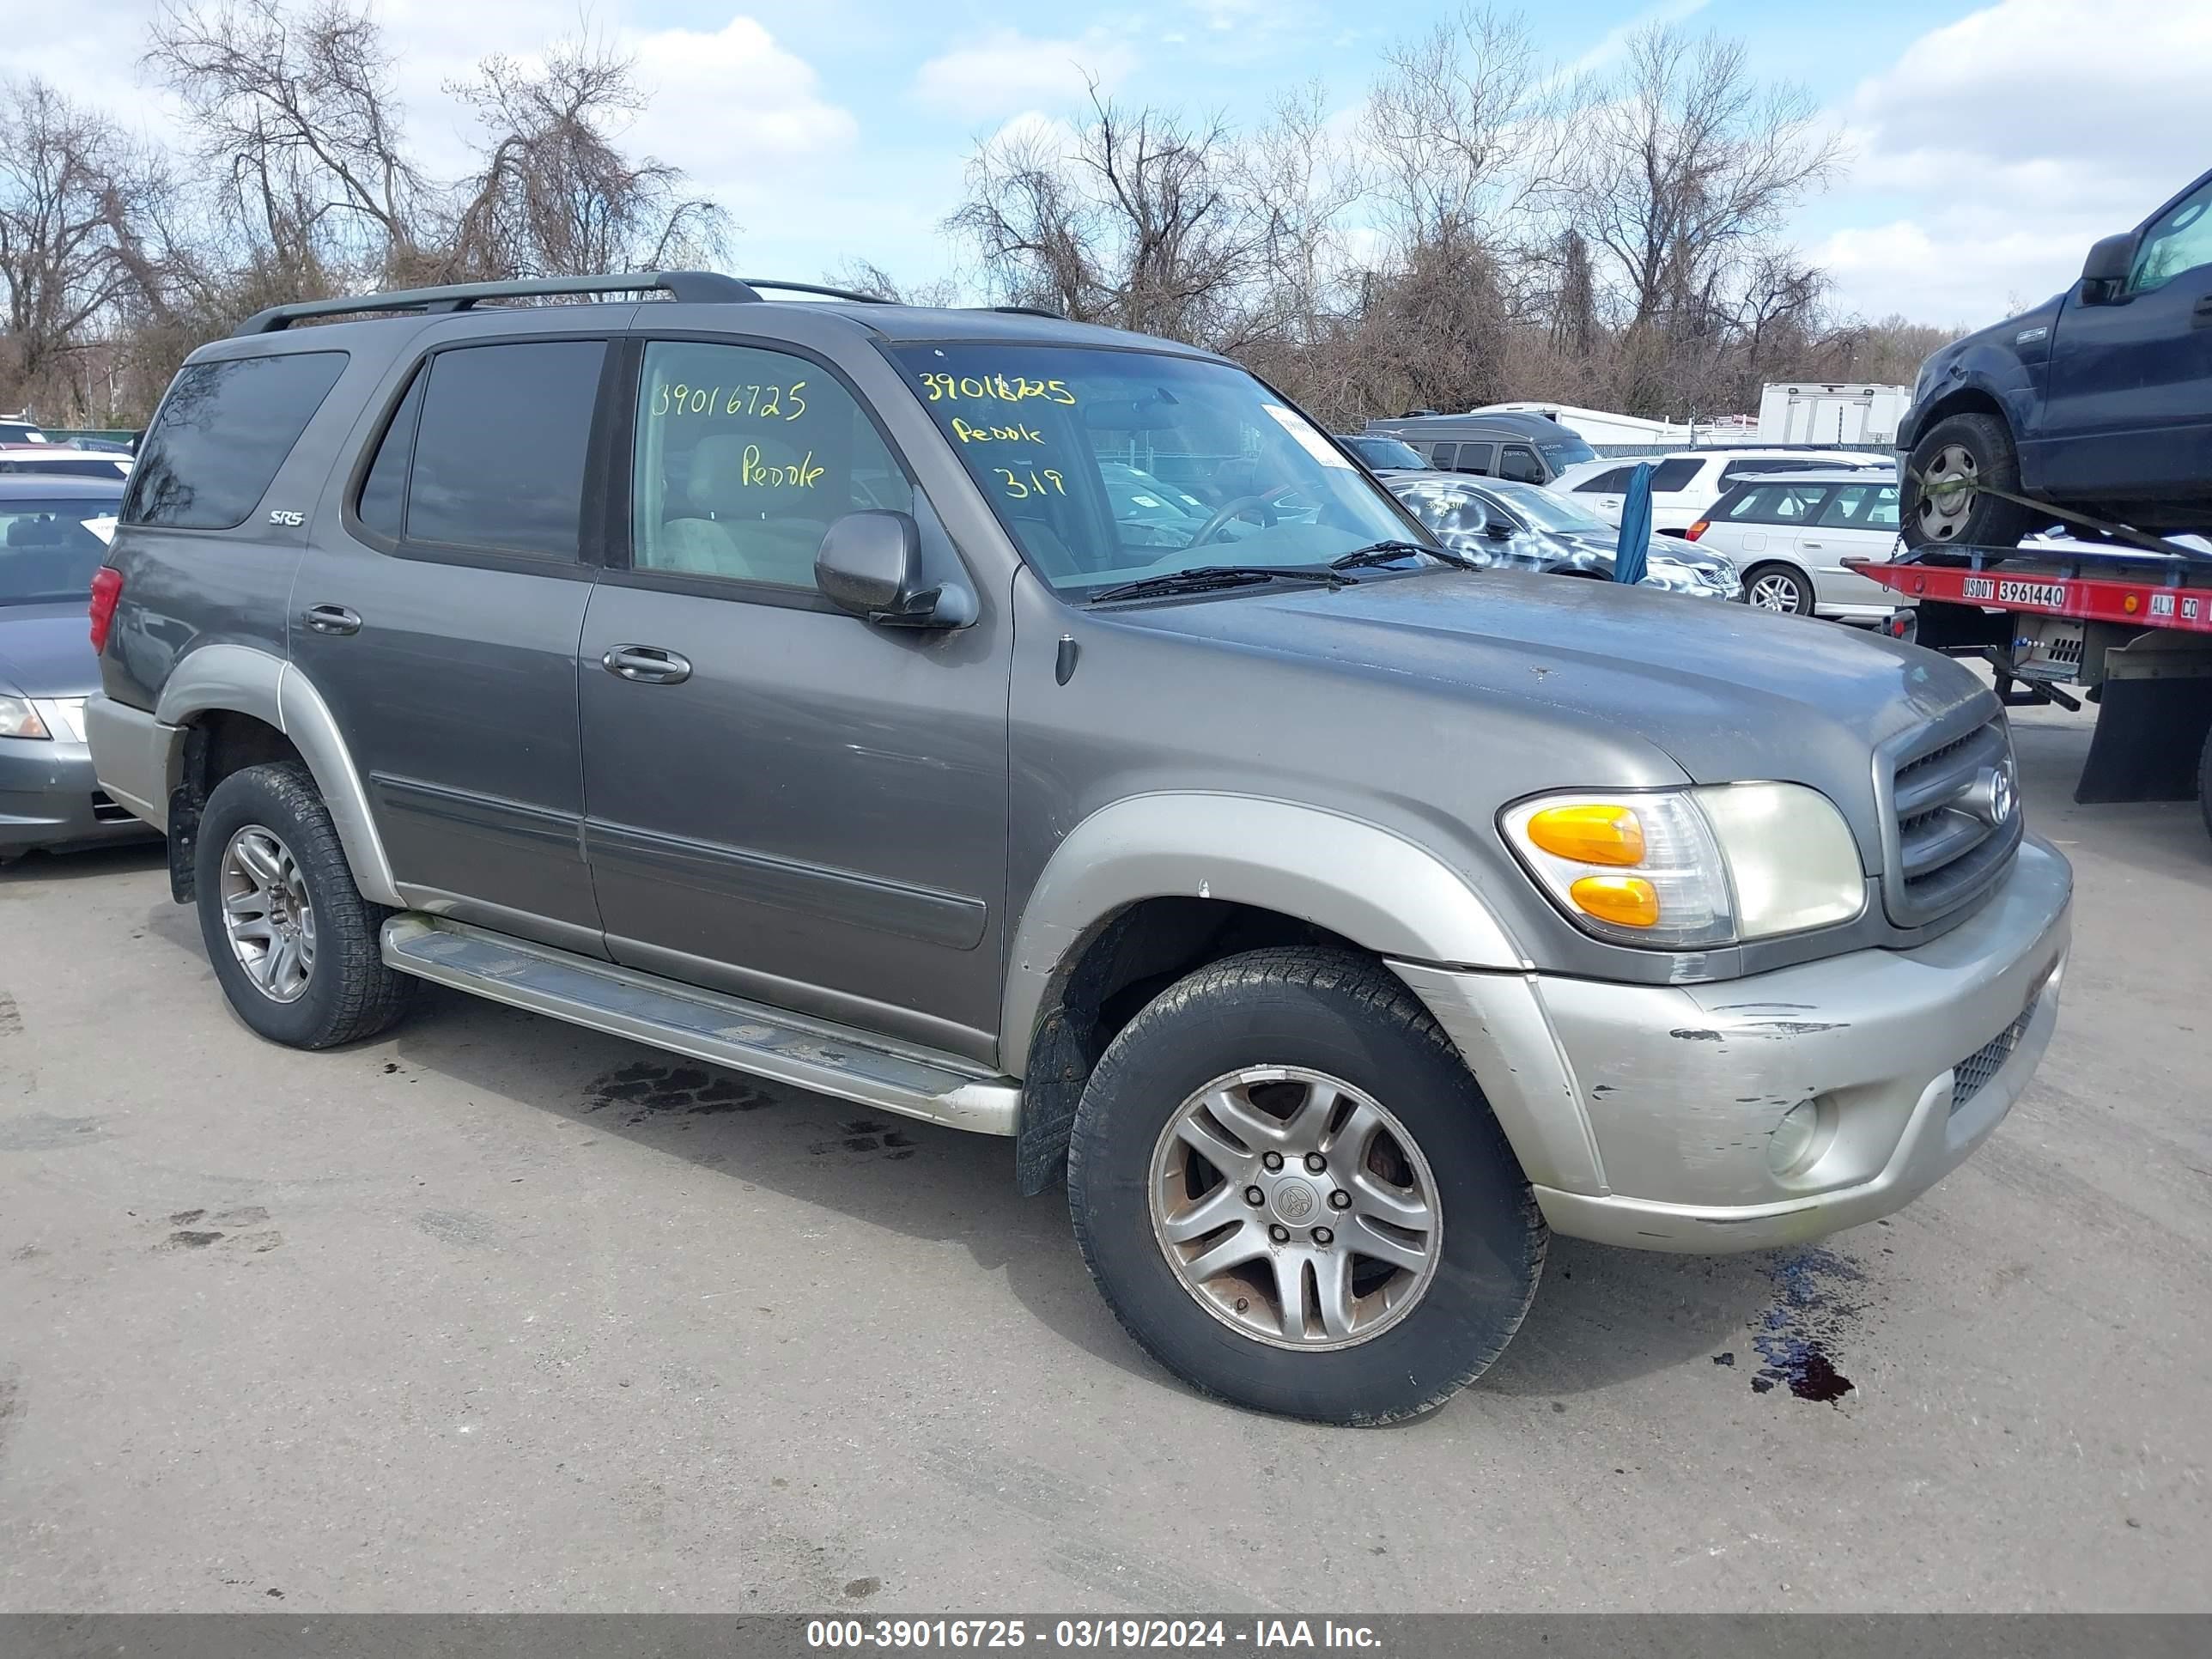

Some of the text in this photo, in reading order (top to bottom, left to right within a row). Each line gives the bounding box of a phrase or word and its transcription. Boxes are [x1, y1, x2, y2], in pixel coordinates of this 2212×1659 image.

[652, 381, 806, 421] 39016725
[919, 372, 1076, 404] 39016725
[269, 510, 305, 526] SR5
[1964, 579, 2063, 606] USDOT 3961440
[2153, 597, 2198, 617] ALX CO
